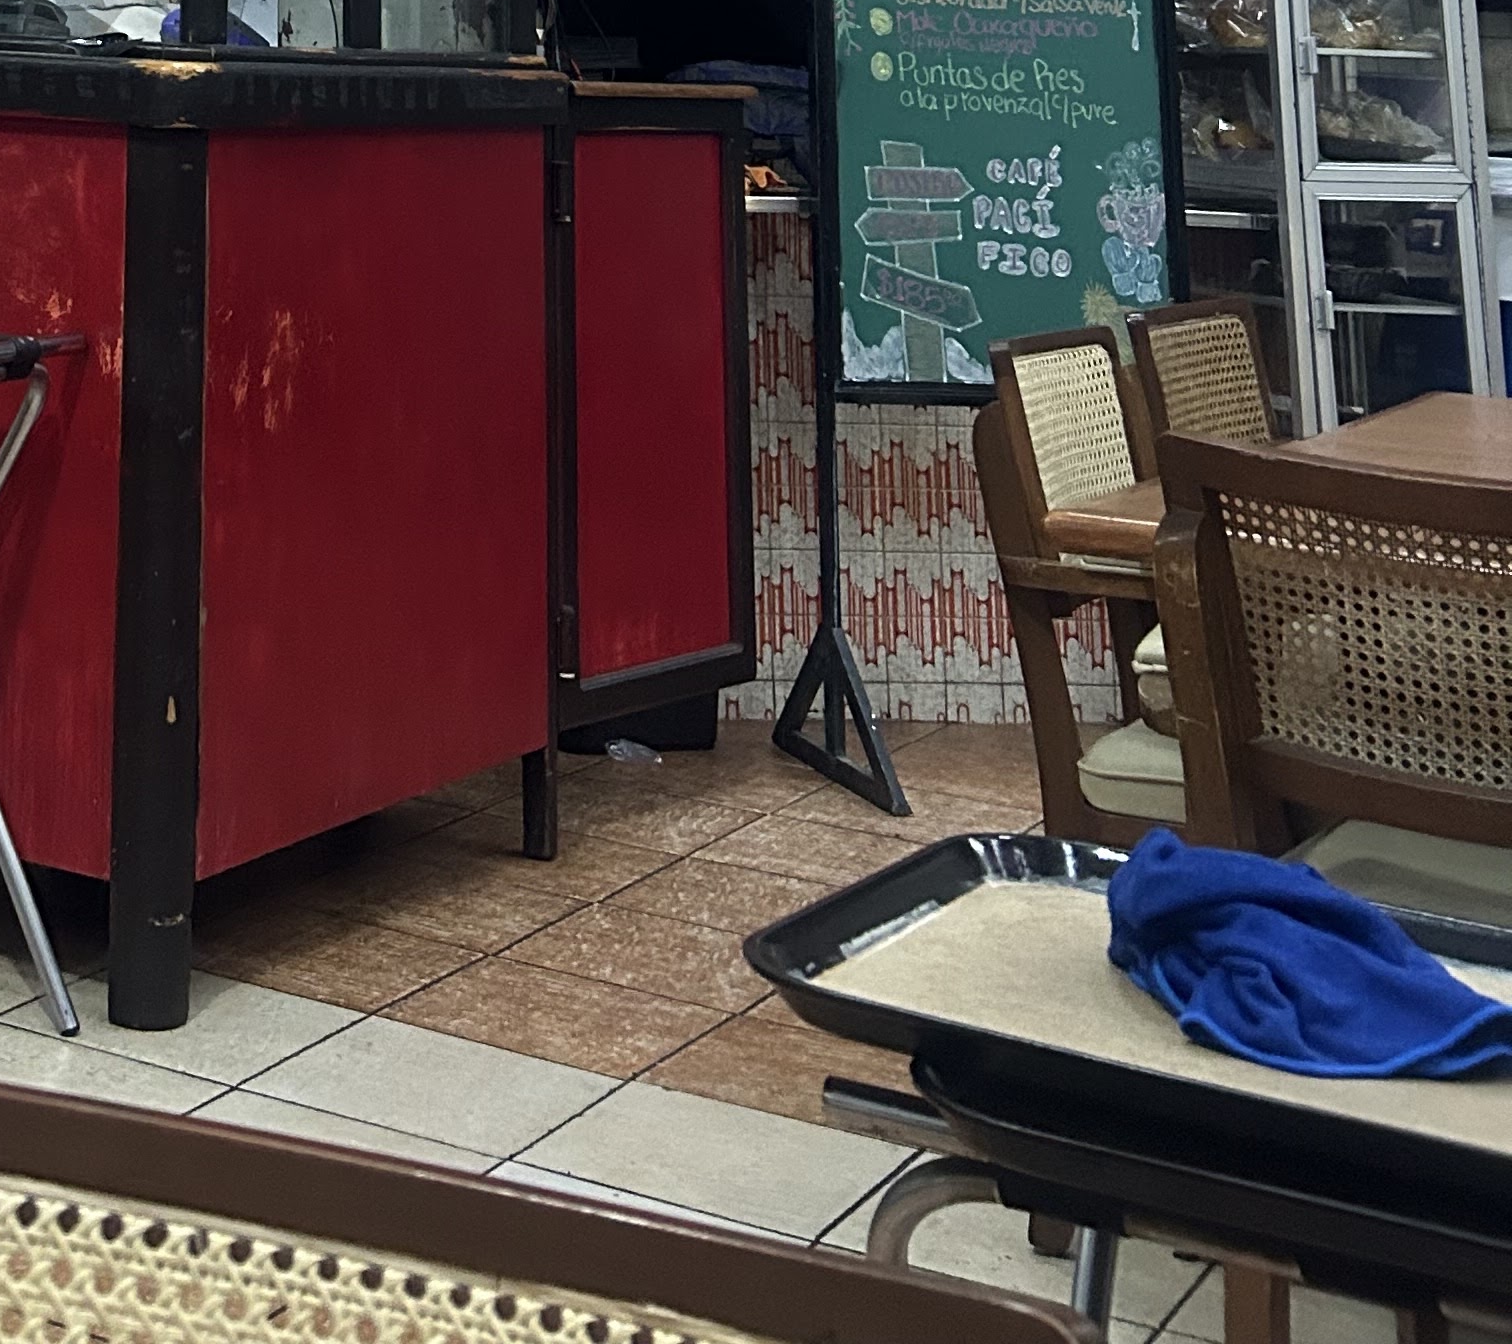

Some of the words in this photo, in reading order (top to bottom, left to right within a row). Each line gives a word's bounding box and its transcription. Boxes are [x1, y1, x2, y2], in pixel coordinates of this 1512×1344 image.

[898, 51, 988, 90] Puntas
[991, 59, 1026, 93] de
[1033, 58, 1085, 93] Res
[986, 144, 1063, 188] CAFÉ
